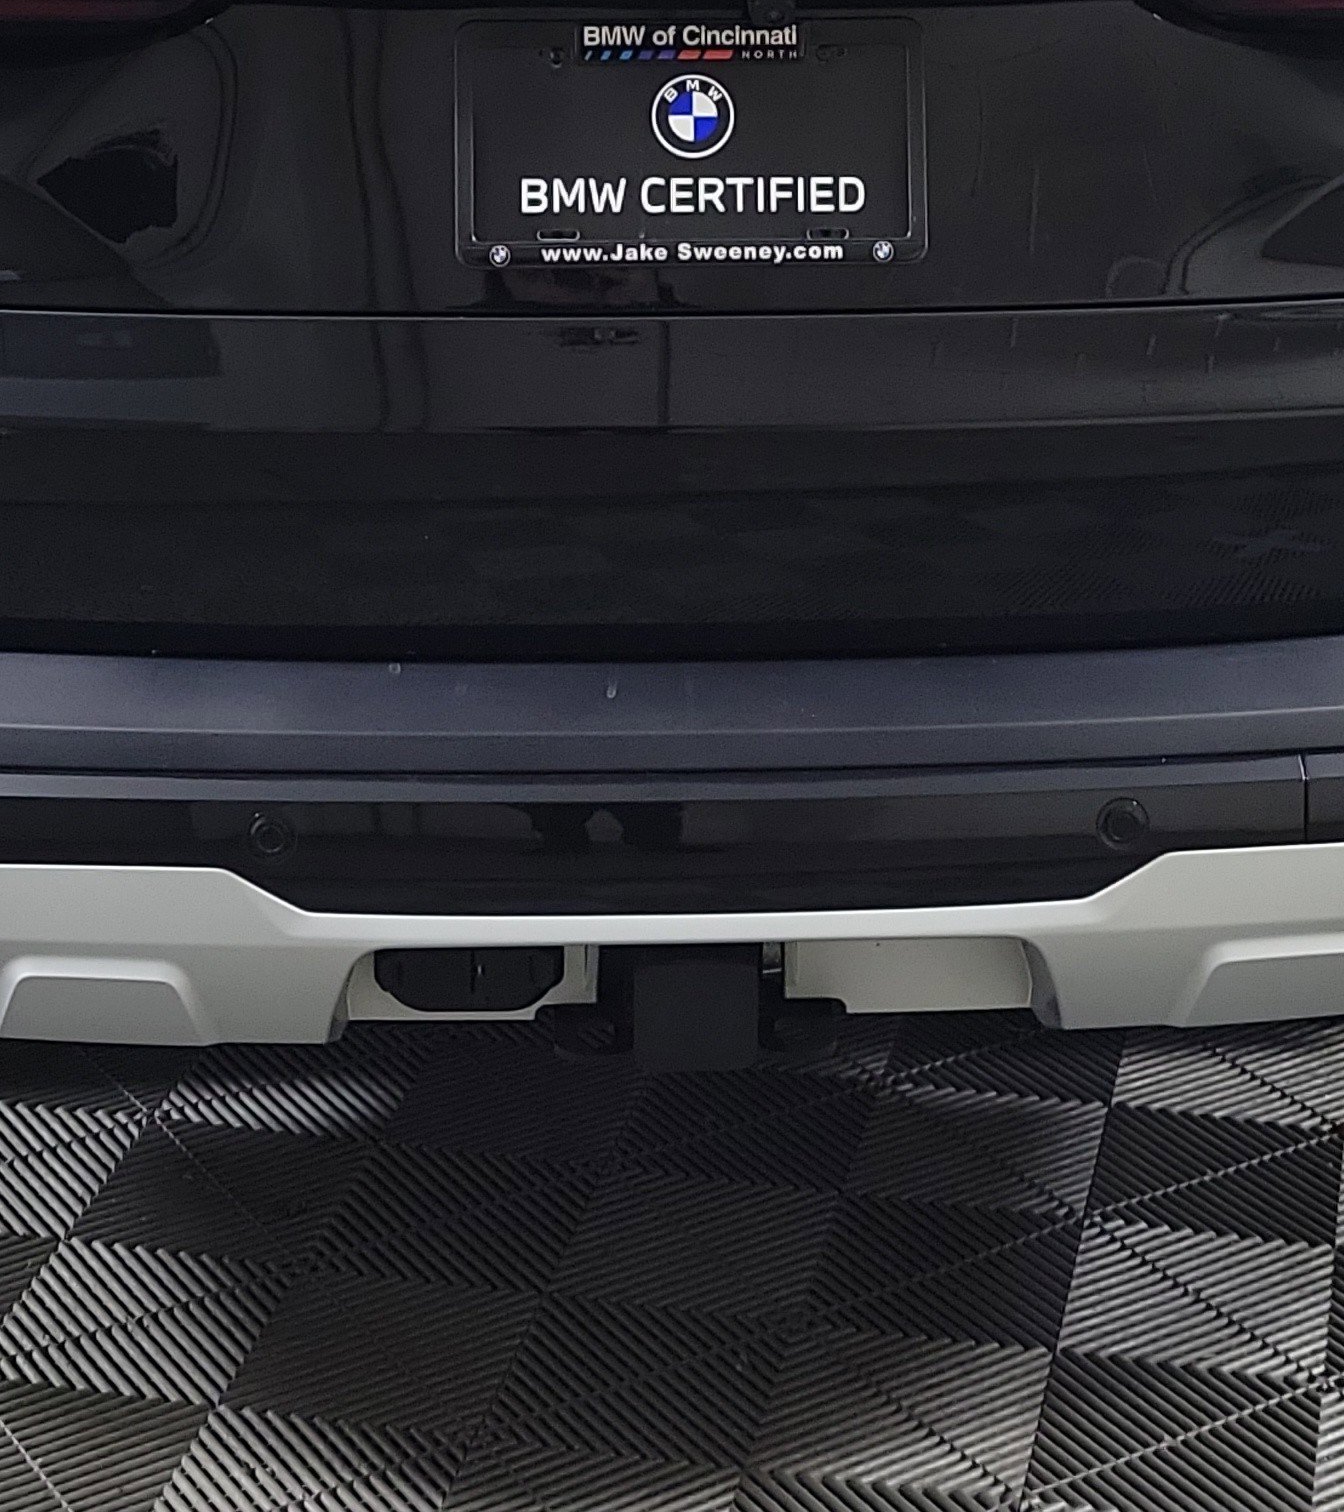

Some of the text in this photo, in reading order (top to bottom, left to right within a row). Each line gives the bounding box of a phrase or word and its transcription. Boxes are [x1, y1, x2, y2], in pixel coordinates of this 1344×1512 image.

[583, 24, 798, 47] BMW of Cincinnati
[741, 49, 798, 60] NORTH
[663, 79, 723, 103] BMW
[520, 176, 866, 214] BMW CERTIFIED
[541, 242, 844, 264] www.Jake Sweeney.com
